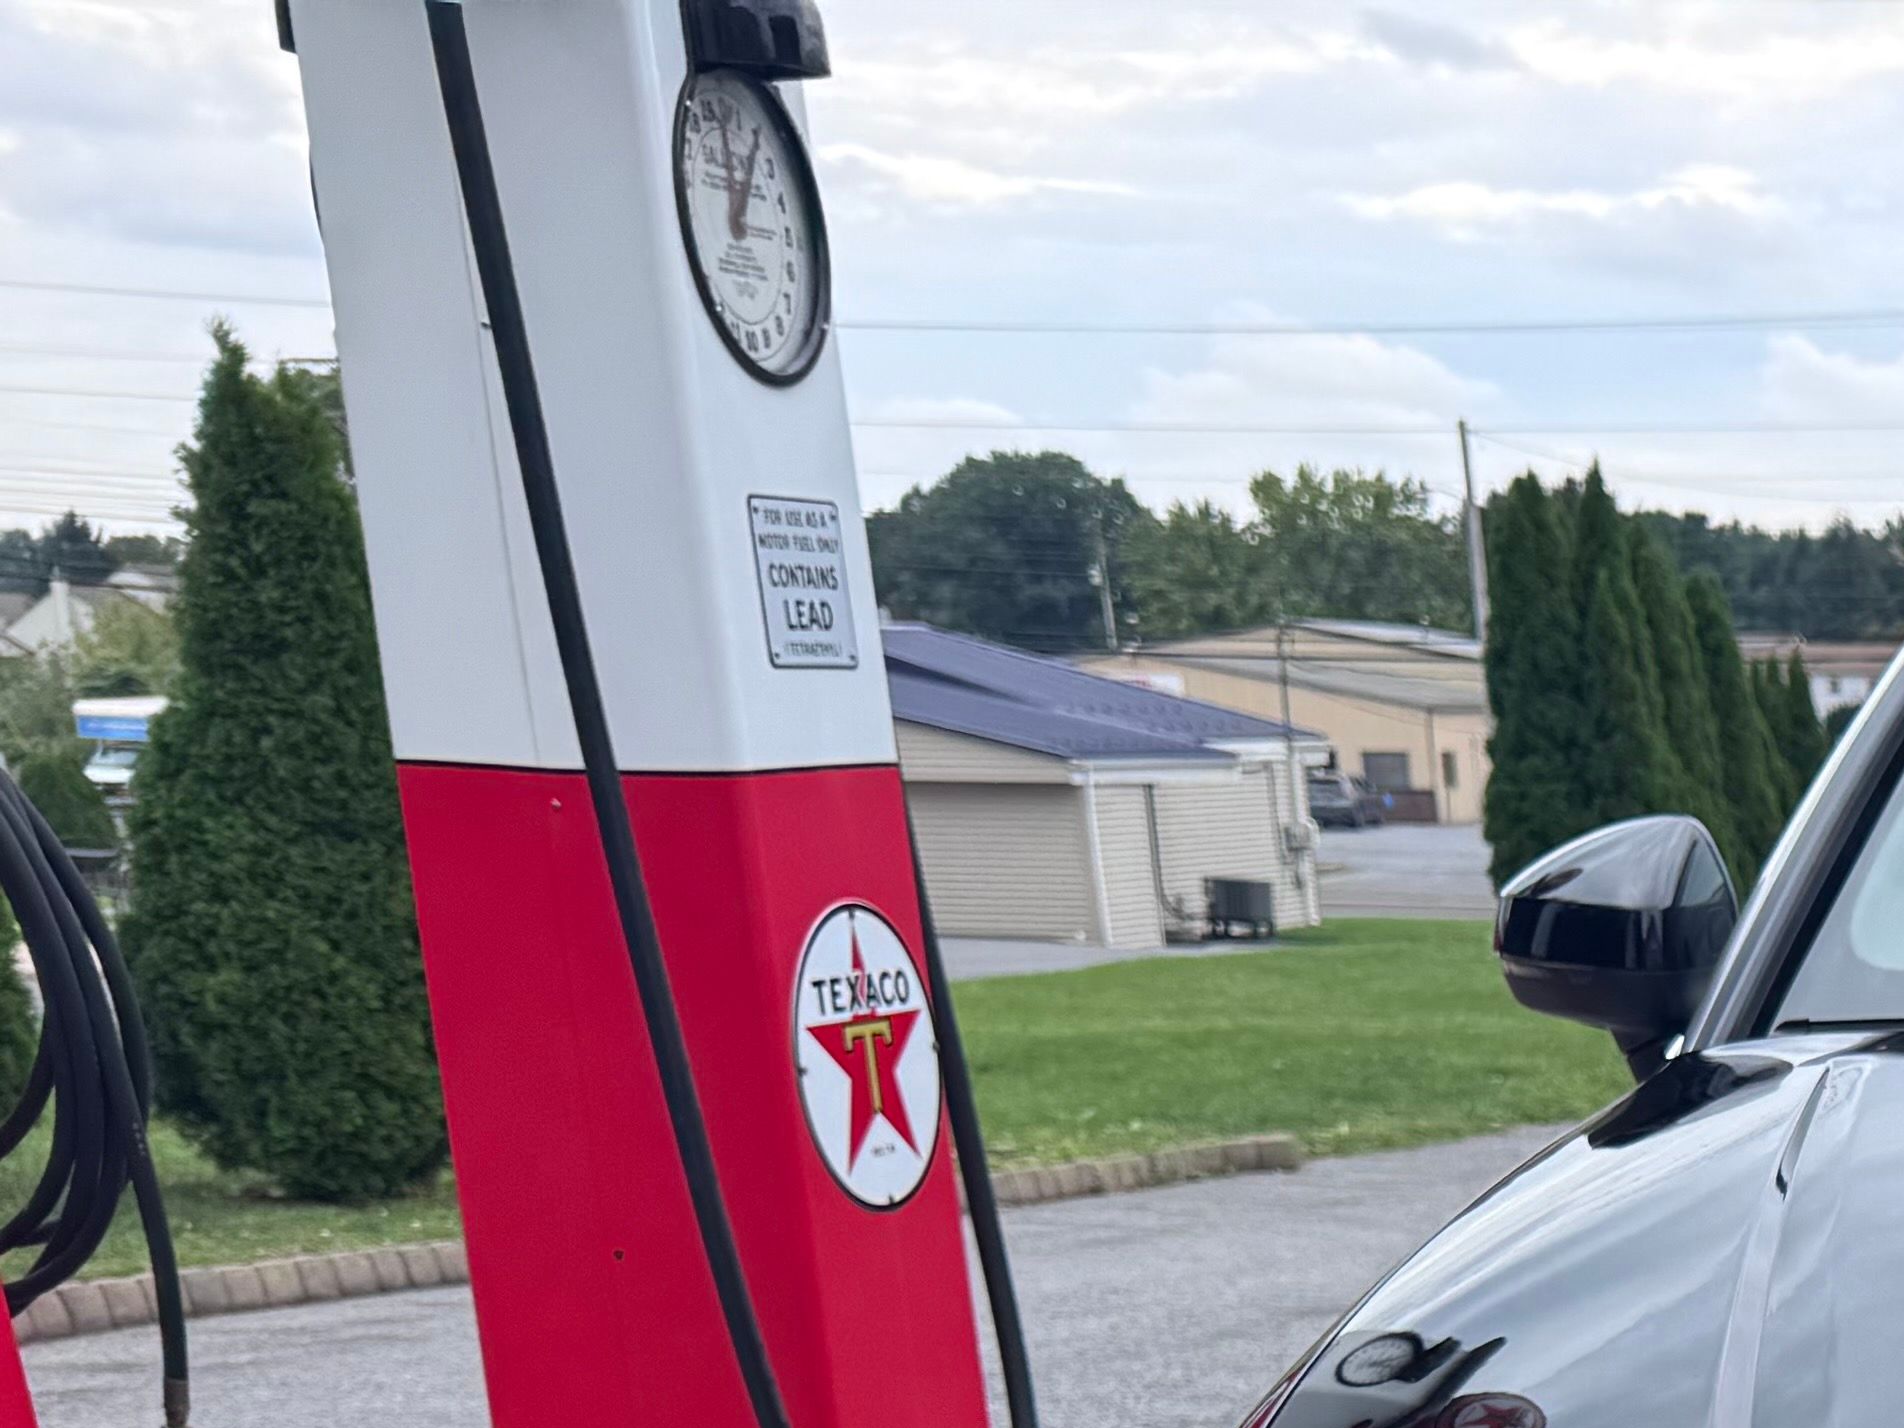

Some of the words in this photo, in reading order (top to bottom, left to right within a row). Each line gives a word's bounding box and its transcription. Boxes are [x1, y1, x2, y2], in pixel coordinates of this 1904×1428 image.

[763, 508, 781, 525] FOR
[758, 533, 789, 550] MOTOR
[792, 535, 815, 552] FUEL
[769, 563, 839, 591] CONTAINS
[783, 599, 834, 631] LEAD
[811, 969, 910, 1016] TEXACO
